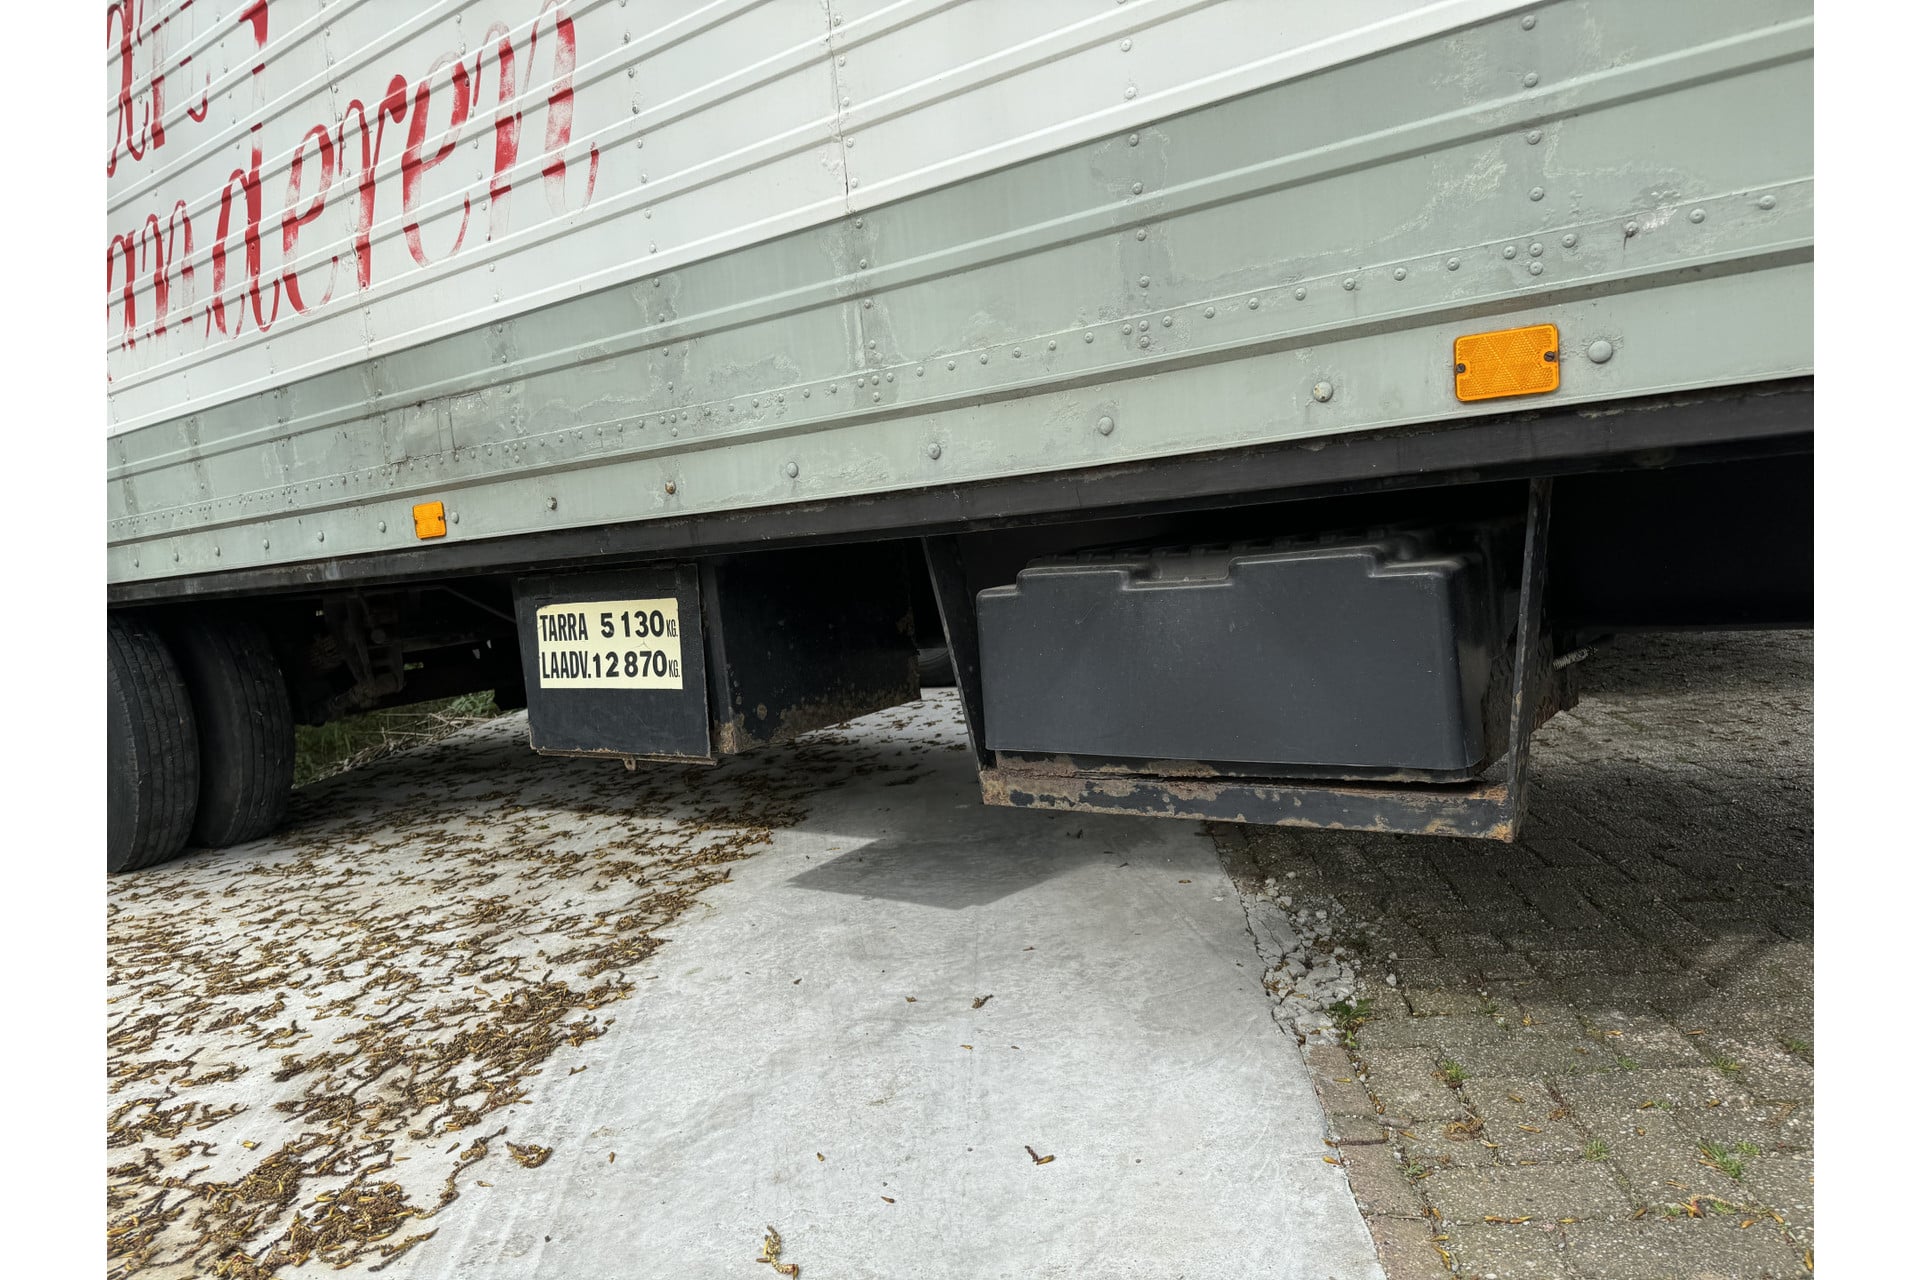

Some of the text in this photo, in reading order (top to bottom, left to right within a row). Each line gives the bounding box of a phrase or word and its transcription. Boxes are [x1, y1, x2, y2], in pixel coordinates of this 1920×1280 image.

[539, 612, 589, 642] TARRA
[665, 619, 679, 638] KG.
[541, 650, 591, 679] LAADV.
[668, 659, 681, 678] KG.
